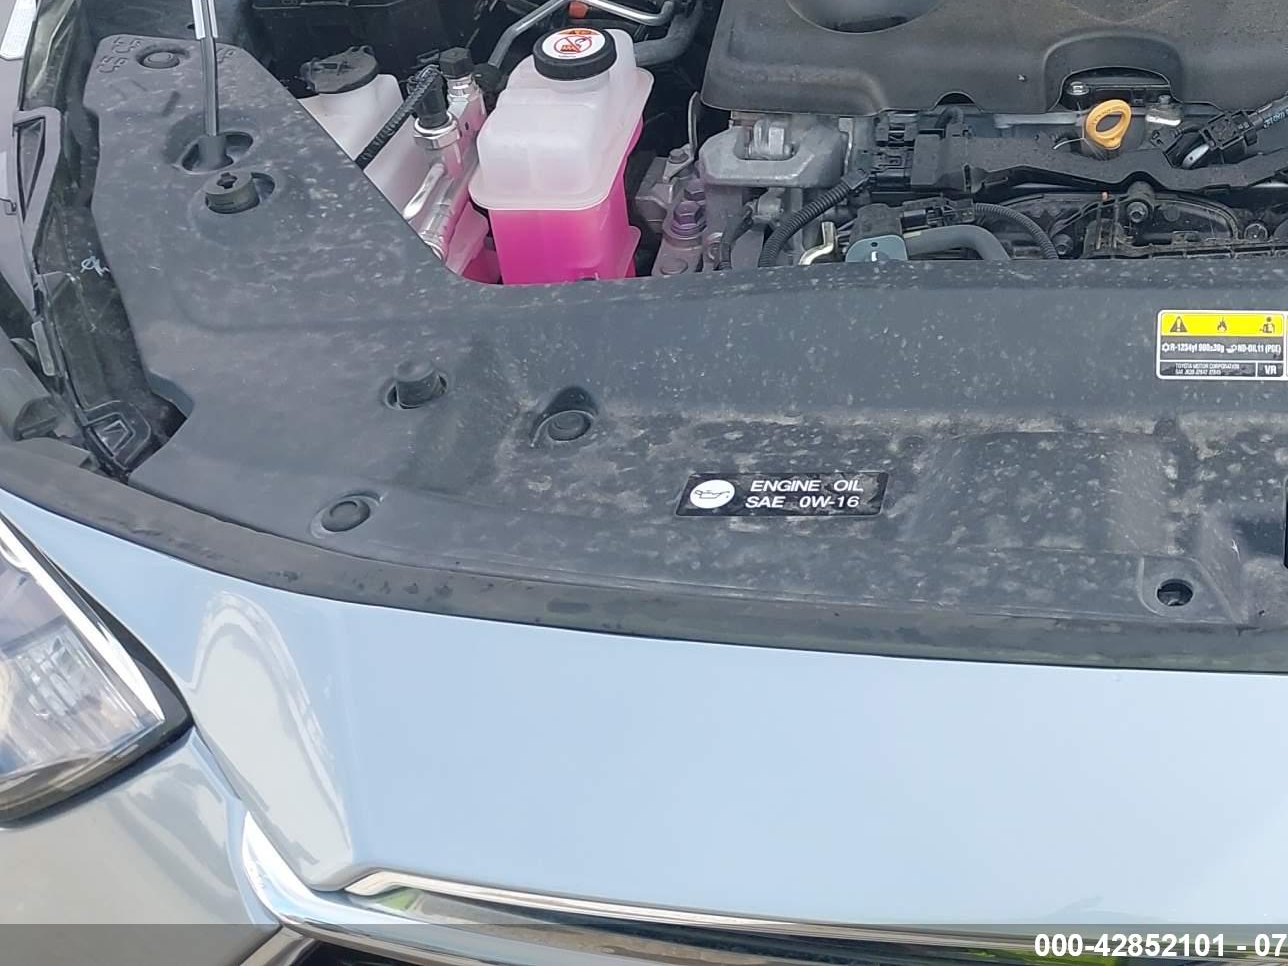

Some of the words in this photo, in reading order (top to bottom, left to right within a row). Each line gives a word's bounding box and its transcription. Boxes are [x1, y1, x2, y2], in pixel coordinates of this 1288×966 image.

[1264, 365, 1277, 375] VR
[749, 479, 821, 492] ENGINE
[833, 479, 864, 492] OIL
[745, 495, 786, 508] SAE
[799, 495, 860, 508] 0W-16
